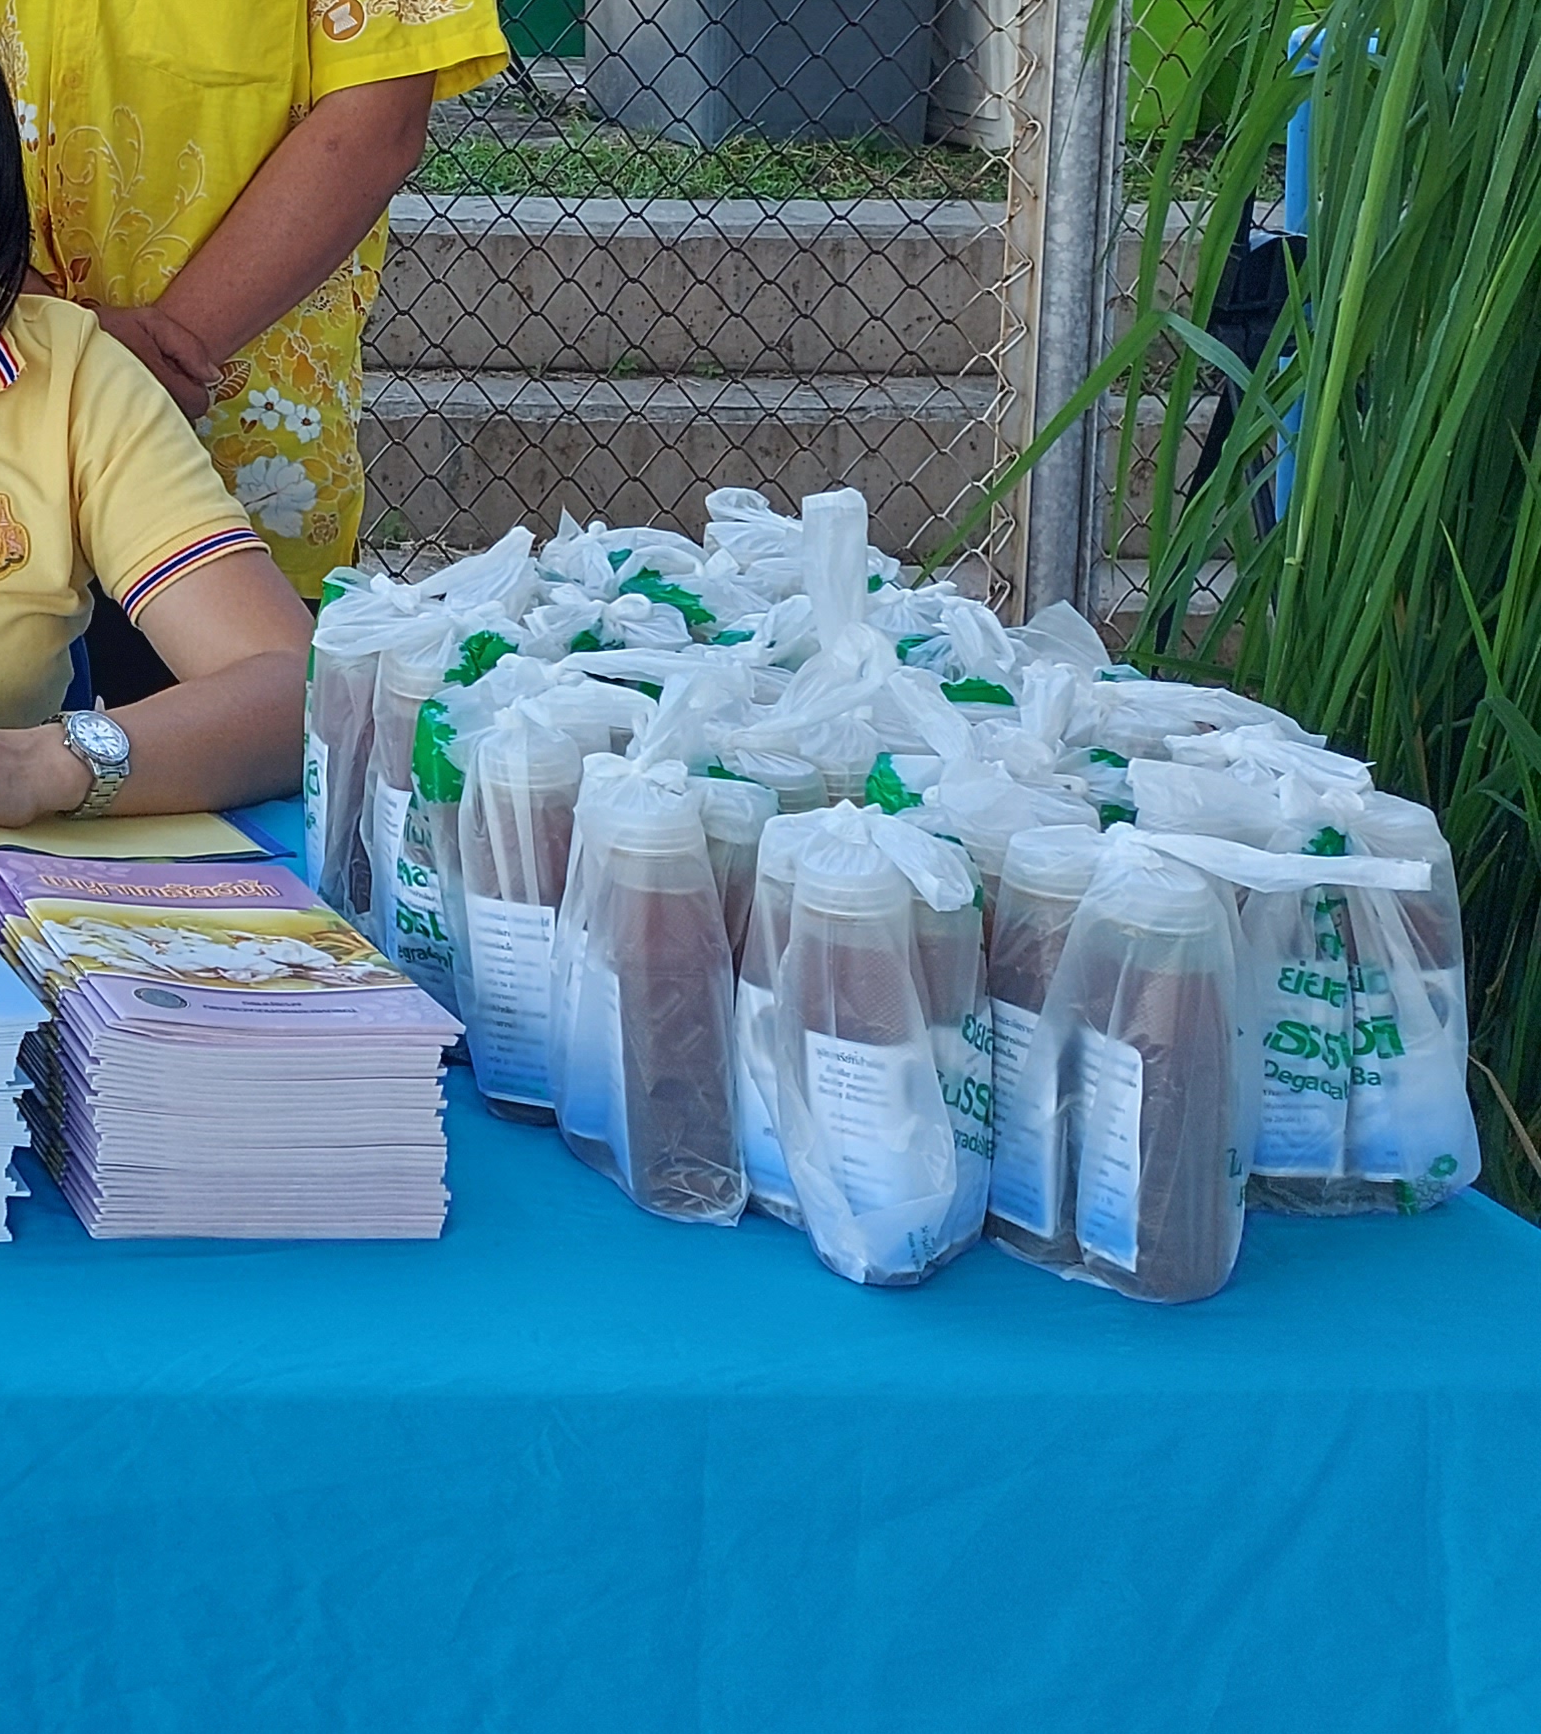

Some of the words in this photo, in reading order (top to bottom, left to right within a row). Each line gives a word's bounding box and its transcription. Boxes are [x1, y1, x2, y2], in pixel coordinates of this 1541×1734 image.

[38, 874, 282, 898] เมนูจากสัตว์น้ำ
